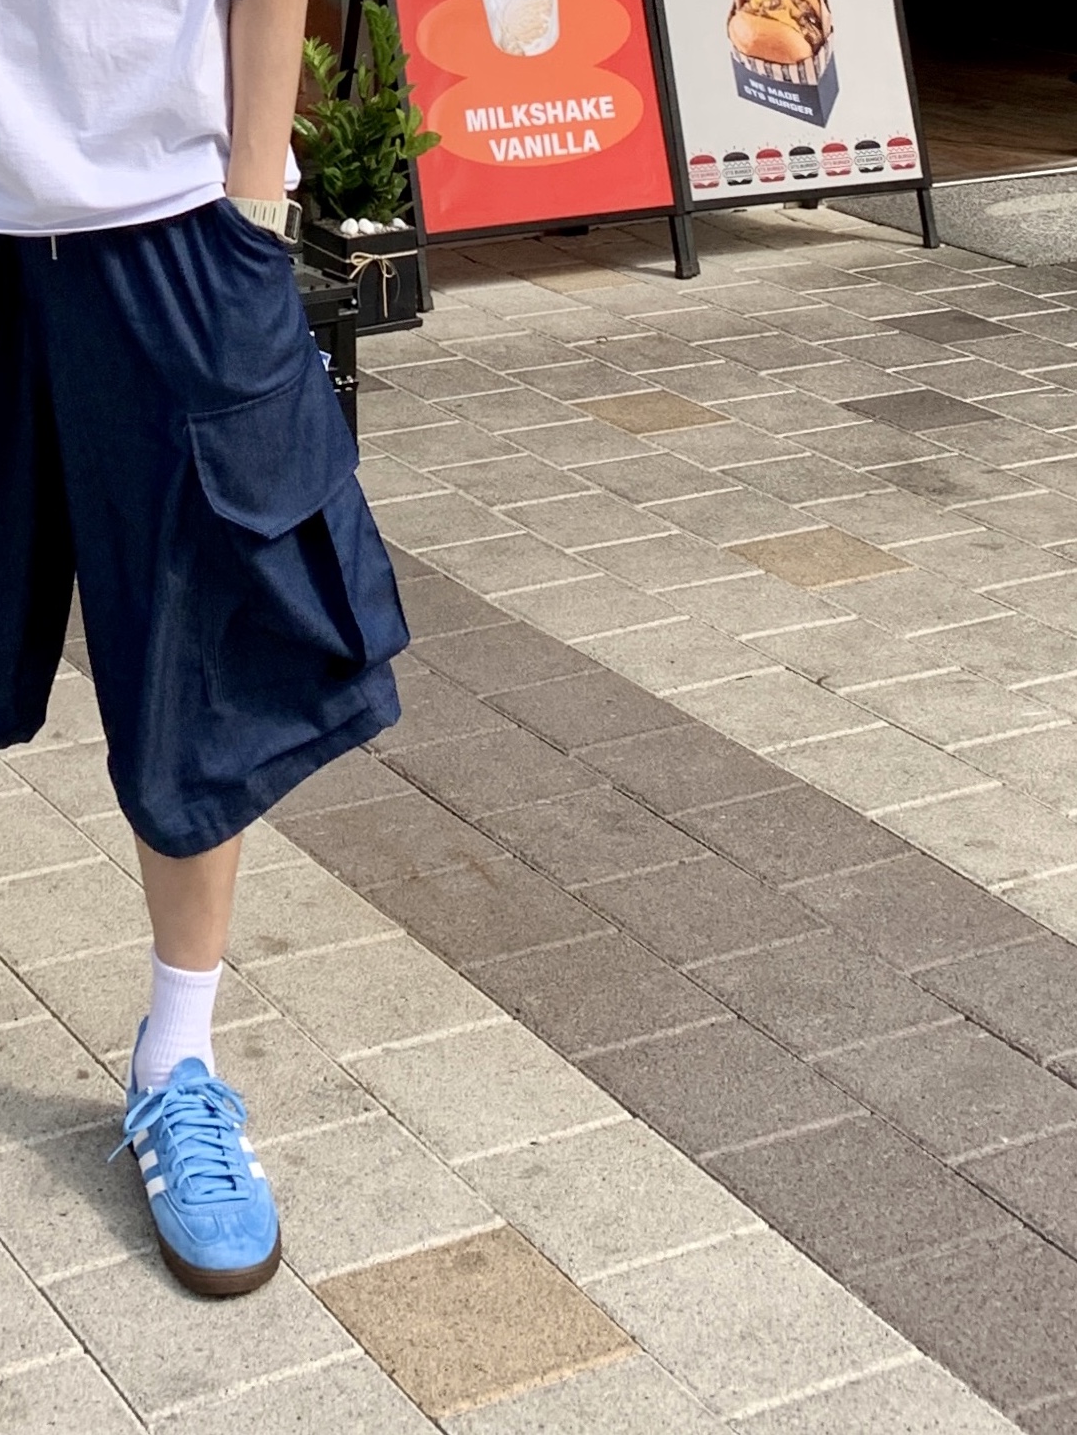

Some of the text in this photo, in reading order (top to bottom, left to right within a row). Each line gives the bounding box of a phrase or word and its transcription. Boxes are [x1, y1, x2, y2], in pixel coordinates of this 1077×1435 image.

[748, 78, 801, 103] WE MADE
[464, 95, 615, 134] MILKSHAKE
[766, 95, 814, 116] BURGER
[488, 129, 601, 163] VANILLA
